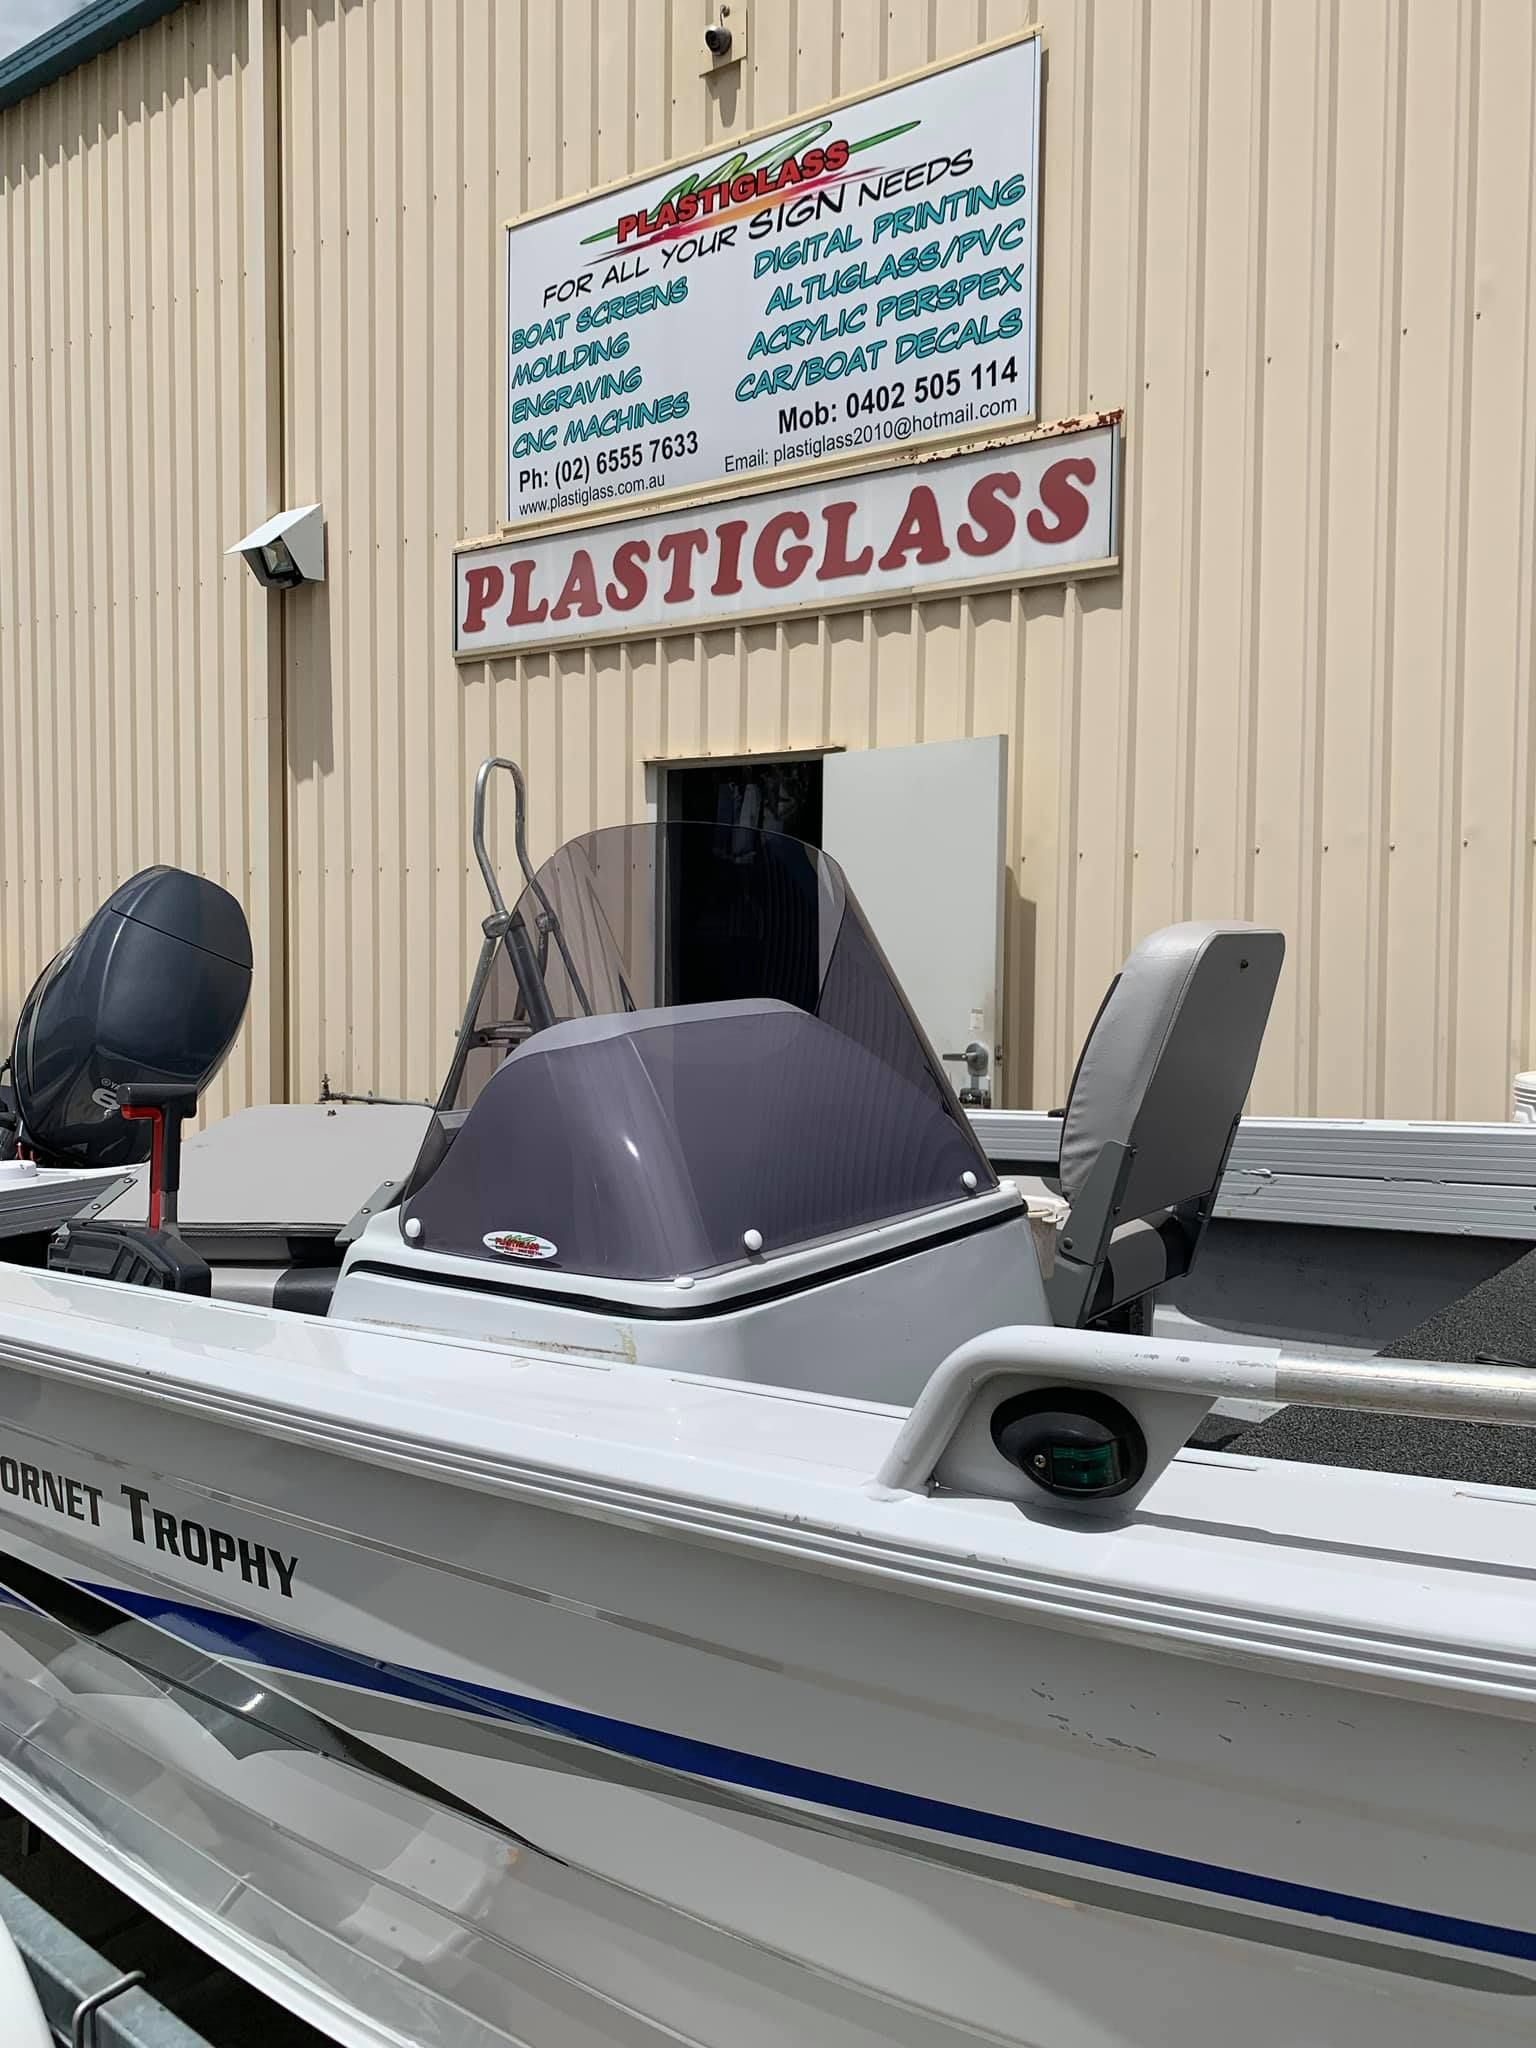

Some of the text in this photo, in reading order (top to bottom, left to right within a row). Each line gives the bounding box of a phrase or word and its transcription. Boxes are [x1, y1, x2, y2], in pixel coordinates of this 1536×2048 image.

[543, 149, 973, 307] FOR ALL YOUR SIGN NEEDS
[617, 139, 849, 243] PLASTIGLASS
[753, 175, 1025, 279] DIGITAL PRINTING
[765, 219, 1025, 315] ALTUGLASS/PVC
[511, 277, 688, 354] BOAT SCREENS
[747, 264, 1024, 360] ACRYLIC PERSPEX
[511, 332, 630, 389] MOULDING
[735, 308, 1022, 402] CAR/BOAT DECALS
[512, 367, 642, 425] ENGRAVING
[512, 392, 689, 459] CNC MACHINES
[778, 356, 1018, 434] Mob: 0402 505 114
[519, 430, 698, 493] Ph: (02) 6555 7633
[725, 397, 1017, 473] Email: plastiglass2010@hotmail.com
[519, 473, 665, 516] www.plastiglass.com.au
[462, 457, 1096, 632] PLASTIGLASS
[0, 1456, 103, 1527] ORNET
